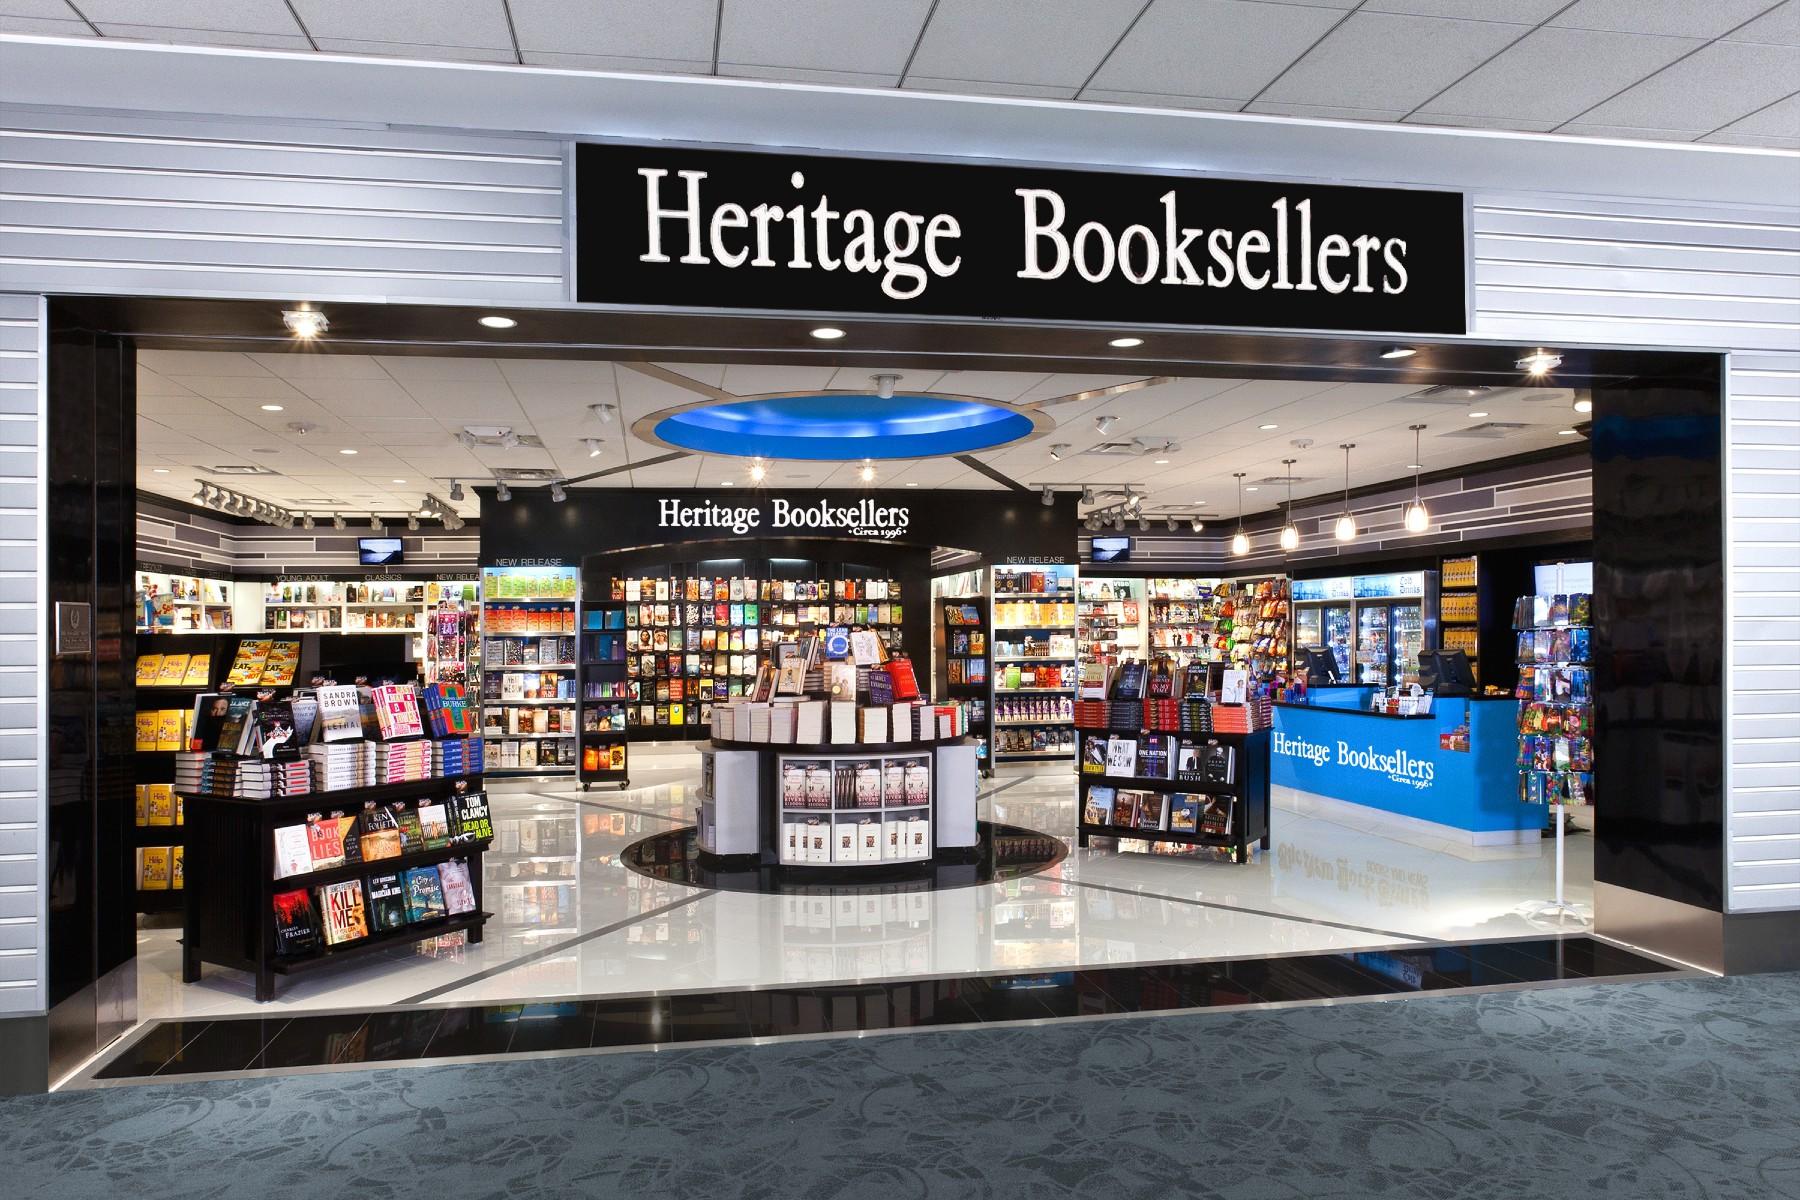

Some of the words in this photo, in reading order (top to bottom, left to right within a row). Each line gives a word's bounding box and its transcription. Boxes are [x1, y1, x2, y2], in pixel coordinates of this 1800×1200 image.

[638, 168, 961, 299] Heritage
[1015, 188, 1408, 294] Booksellers
[658, 499, 760, 534] Heritage
[772, 499, 909, 528] Booksellers
[853, 527, 879, 536] Circa
[880, 527, 902, 539] 1996
[495, 559, 517, 567] NEW
[521, 559, 562, 567] RELEASE
[1006, 556, 1026, 564] NEW
[1028, 556, 1065, 564] RELEASE
[323, 691, 356, 700] SANDRA
[324, 699, 357, 708] BROWN
[442, 700, 468, 708] BURKE
[327, 721, 360, 731] LETHAL
[1274, 732, 1330, 767] Heritage
[1337, 741, 1434, 780] Booksellers
[465, 796, 481, 808] TOM
[373, 812, 388, 822] KEN
[461, 805, 488, 820] CLANCY
[463, 820, 479, 831] DEAD
[480, 819, 489, 828] OR
[310, 827, 339, 842] BOOK
[475, 827, 493, 839] ALIVE
[313, 841, 341, 859] LIES
[330, 888, 360, 911] KILL
[332, 908, 355, 930] ME
[285, 928, 311, 939] FRAZIER
